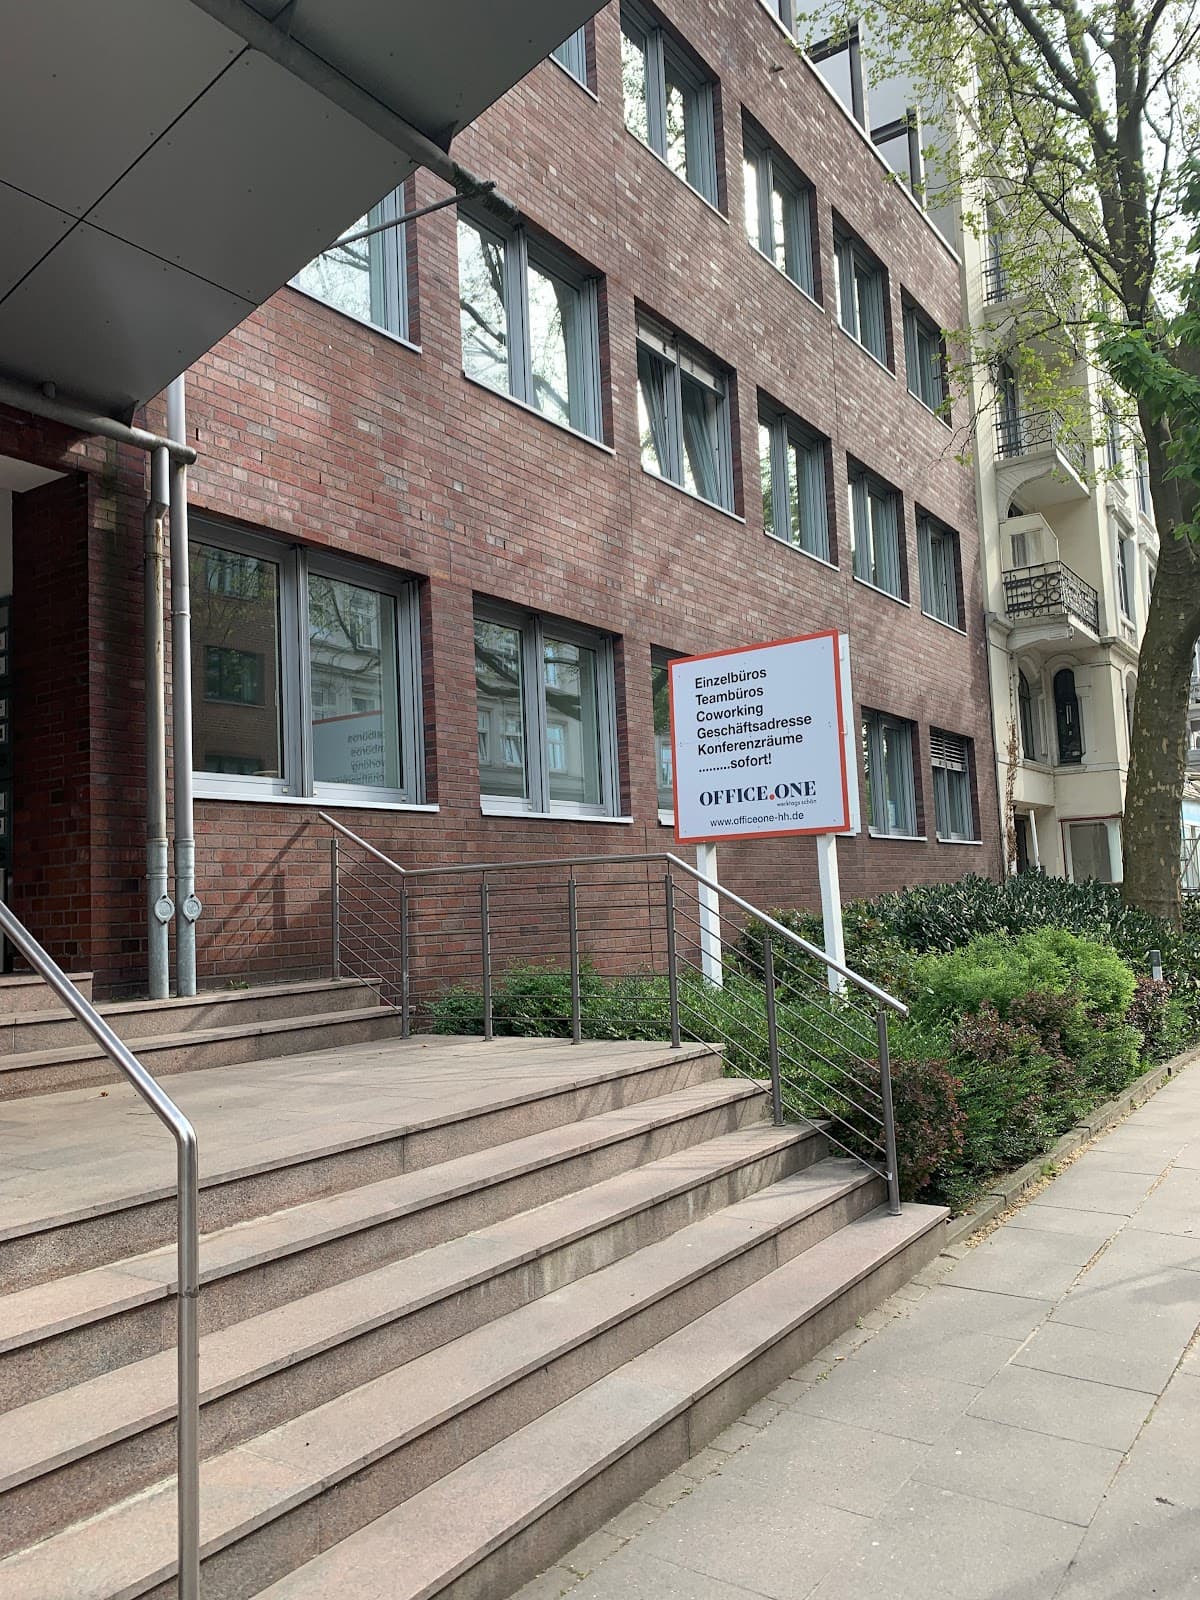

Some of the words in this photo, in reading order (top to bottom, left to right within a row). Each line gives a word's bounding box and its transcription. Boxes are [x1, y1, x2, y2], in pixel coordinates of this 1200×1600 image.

[695, 668, 767, 689] Einzelbüros
[696, 685, 764, 706] Teambüros
[696, 703, 764, 722] Coworking
[697, 714, 812, 739] Geschäftsadresse
[698, 732, 803, 756] Konferenzräume
[699, 780, 816, 807] OFFICE.ONE
[710, 810, 805, 828] www.officeone-hh.de
